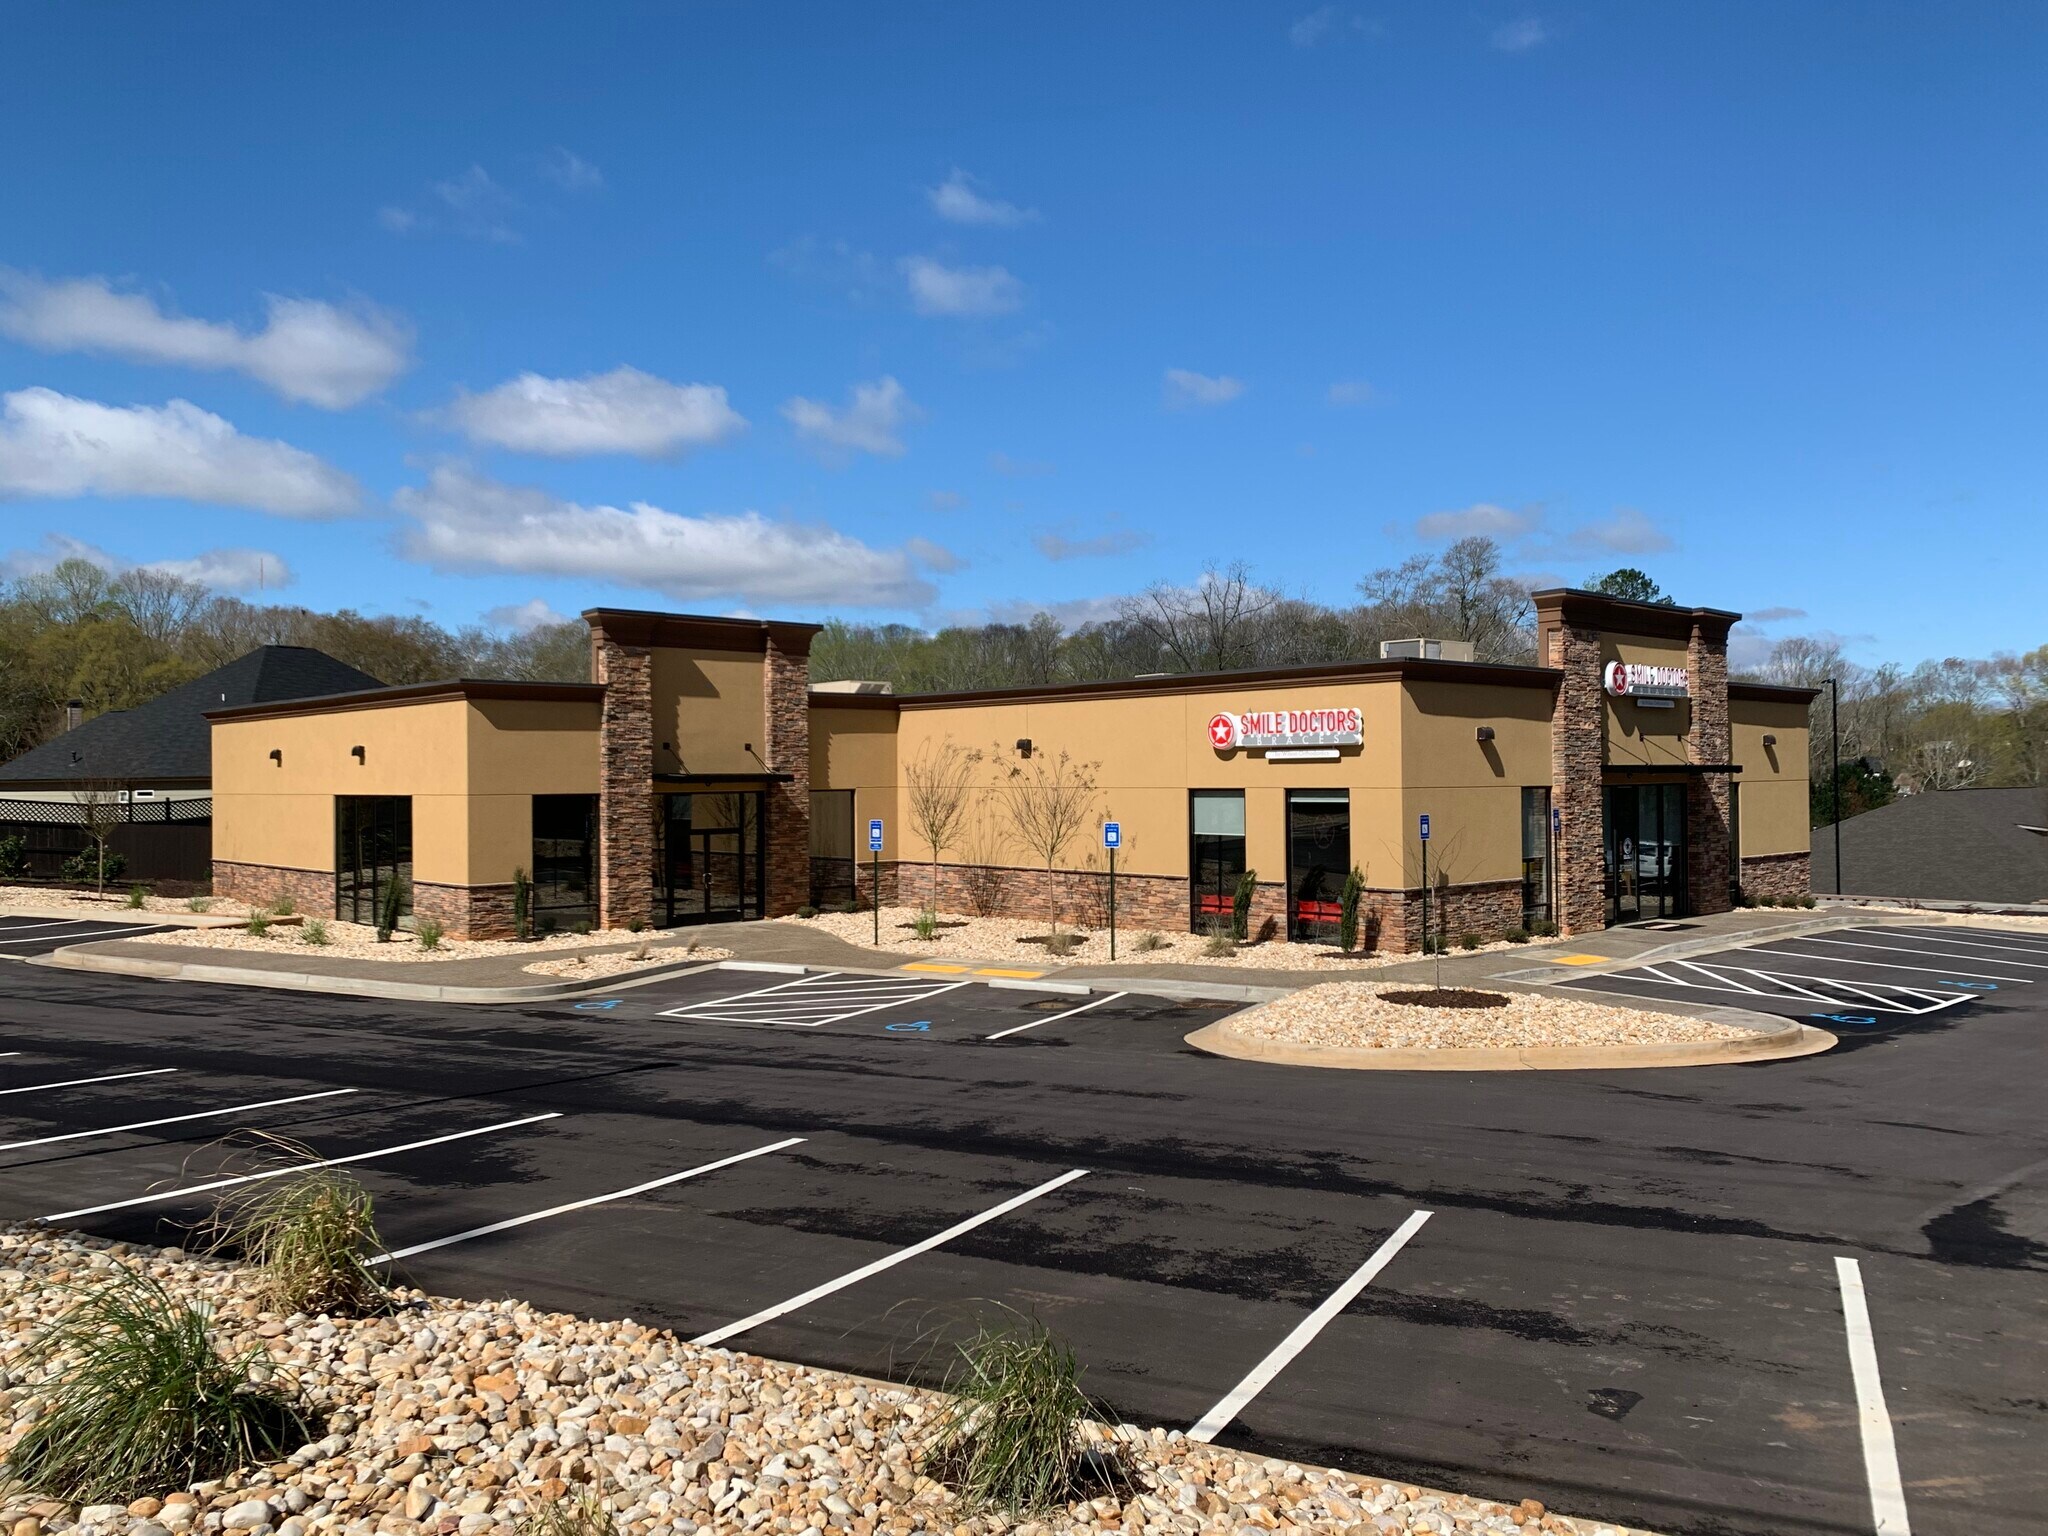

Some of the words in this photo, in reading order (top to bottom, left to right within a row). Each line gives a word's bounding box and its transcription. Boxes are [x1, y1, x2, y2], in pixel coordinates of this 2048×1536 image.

[1240, 713, 1283, 735] SMILE
[1289, 709, 1357, 733] DOCTORS
[1256, 734, 1340, 746] BRACES
